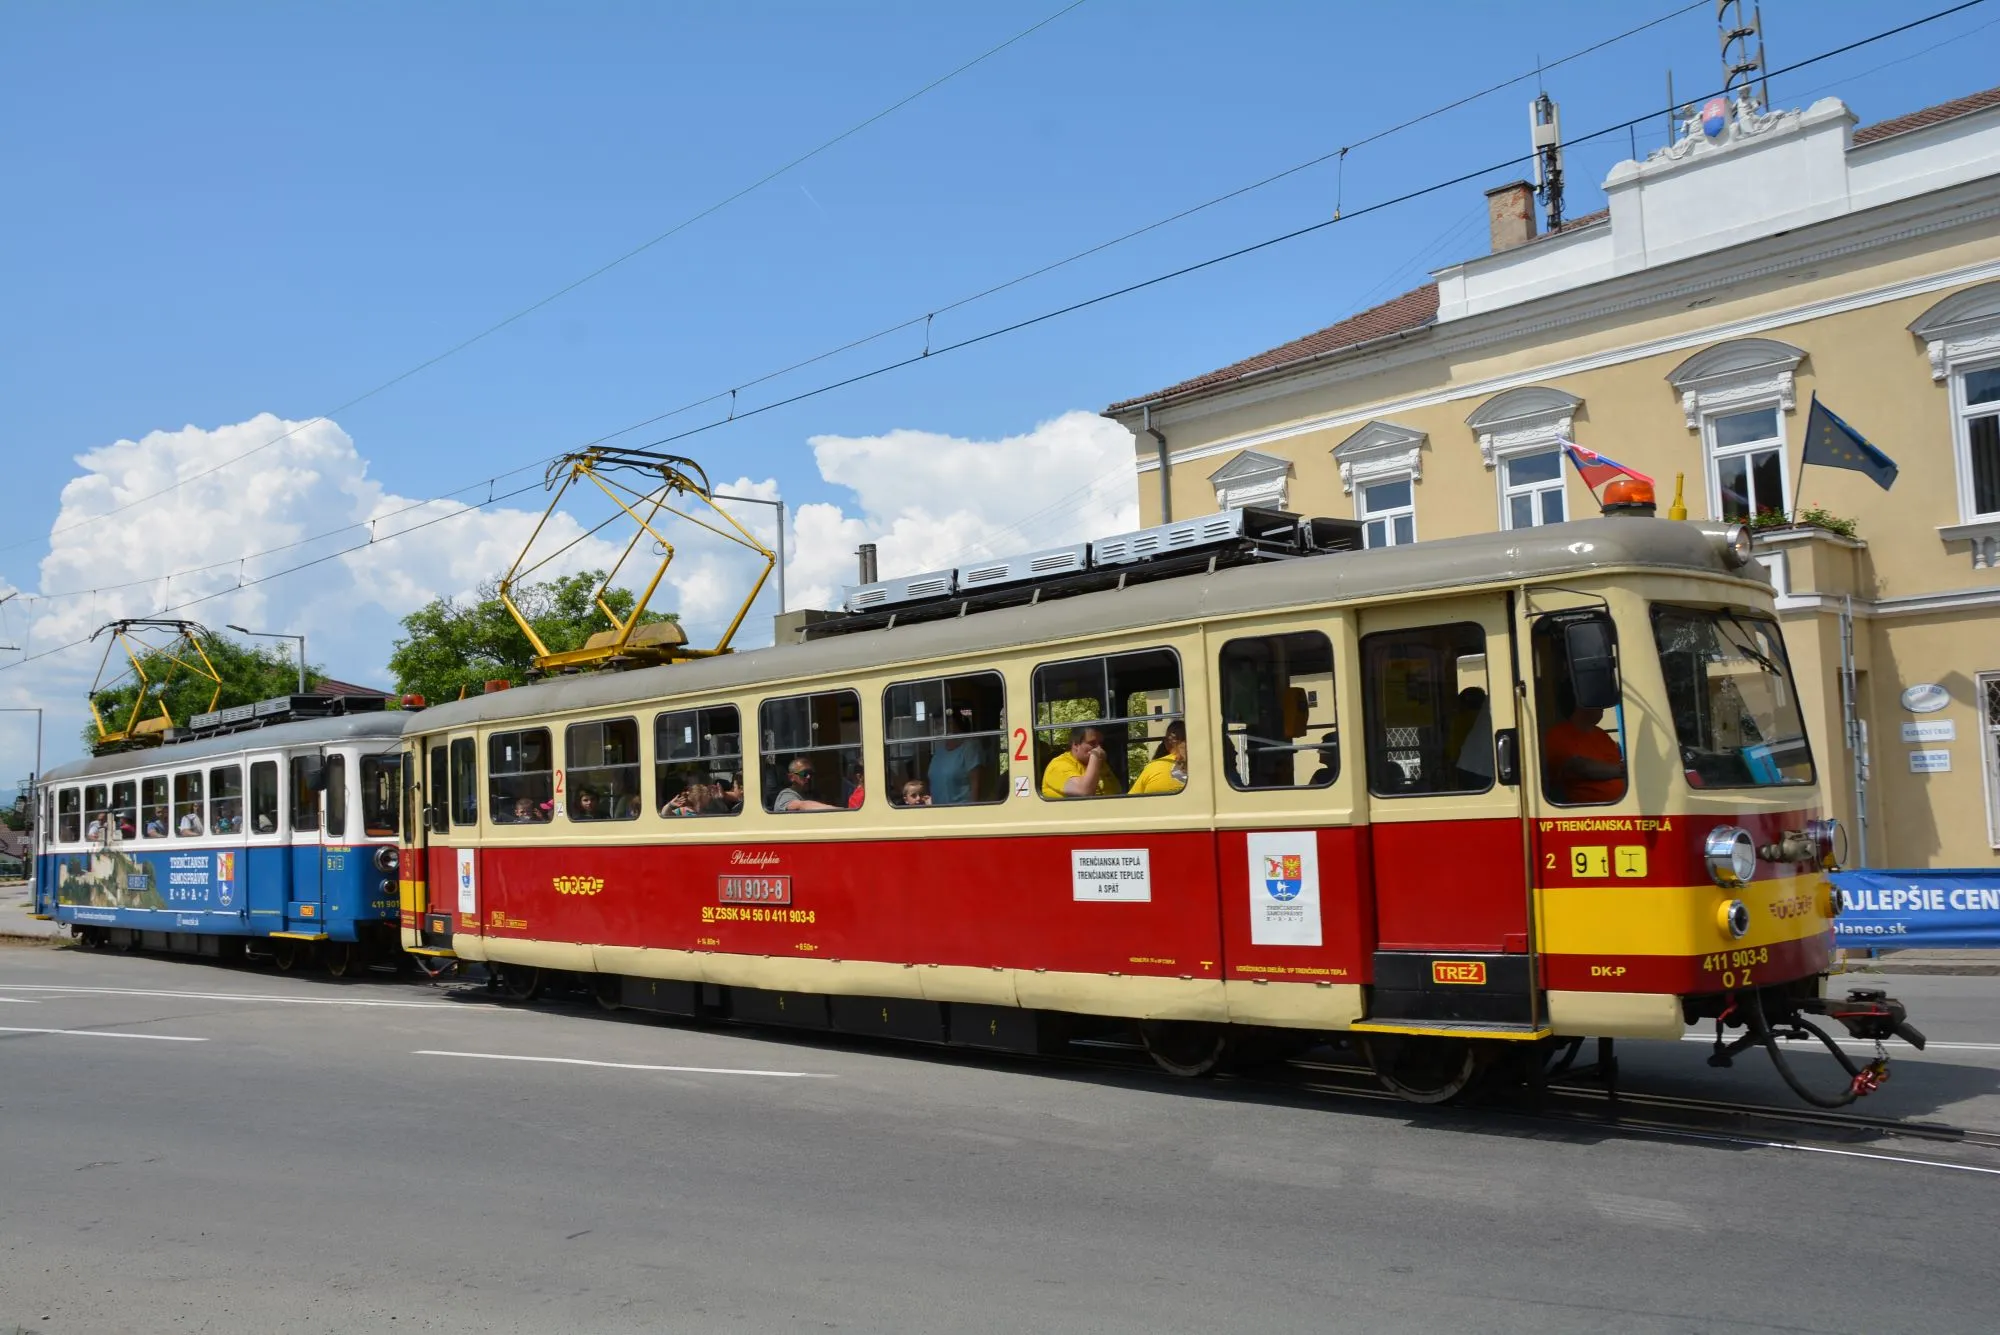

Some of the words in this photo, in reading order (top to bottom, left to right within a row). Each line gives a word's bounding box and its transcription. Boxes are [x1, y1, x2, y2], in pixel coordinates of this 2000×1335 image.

[1014, 728, 1028, 760] 2
[556, 769, 563, 793] 2
[1540, 821, 1553, 832] VP
[1556, 819, 1632, 831] TRENČIANSKA
[1634, 818, 1672, 831] TEPLÁ
[730, 850, 780, 870] Philadelphia
[1079, 856, 1120, 866] TRENČIANSKA
[1122, 856, 1141, 866] TEPLÁ
[1545, 853, 1556, 869] 2
[1575, 852, 1587, 873] 9
[1601, 857, 1607, 873] t
[1078, 870, 1118, 880] TRENČIANSKE
[1120, 871, 1144, 880] TEPLICE
[725, 879, 742, 898] 411
[745, 879, 783, 899] 903-8
[1098, 884, 1102, 893] A
[1842, 885, 1945, 910] AJLEPŠIE
[702, 906, 715, 920] SK
[715, 907, 738, 920] ZSSK
[740, 908, 751, 921] 94
[753, 909, 763, 922] 56
[765, 909, 770, 921] 0
[772, 910, 787, 922] 411
[790, 911, 815, 923] 903-8
[1703, 955, 1728, 972] 411
[1732, 948, 1768, 967] 903-8
[1436, 964, 1478, 980] TREŽ
[1591, 966, 1626, 976] DK-P
[1722, 971, 1735, 988] O
[1741, 969, 1752, 985] Z
